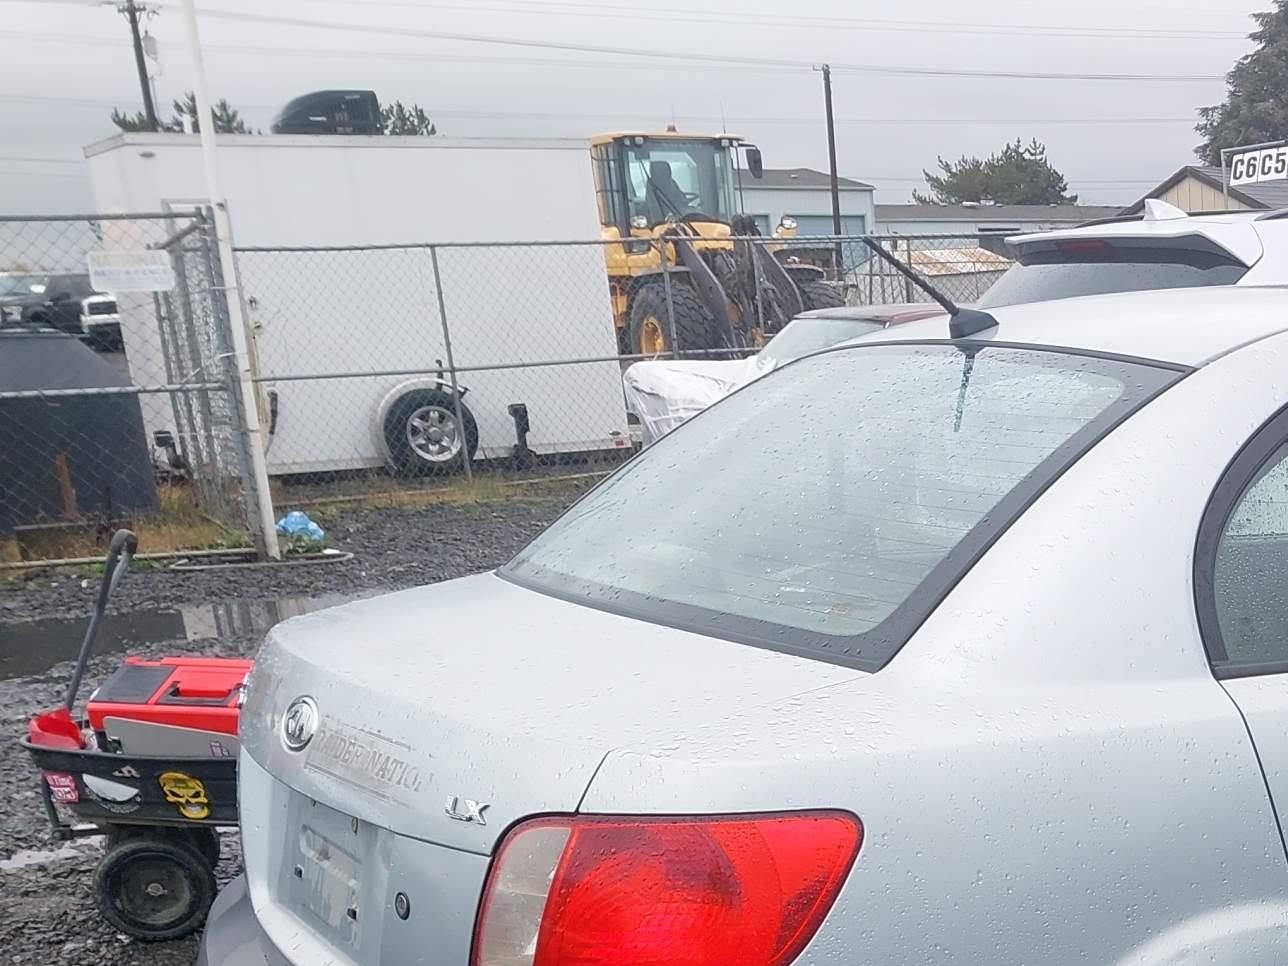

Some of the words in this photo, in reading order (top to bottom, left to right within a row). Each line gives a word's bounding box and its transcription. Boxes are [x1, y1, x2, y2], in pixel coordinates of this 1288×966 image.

[1233, 156, 1258, 181] C6
[1261, 152, 1287, 176] C5
[444, 795, 491, 826] LX
